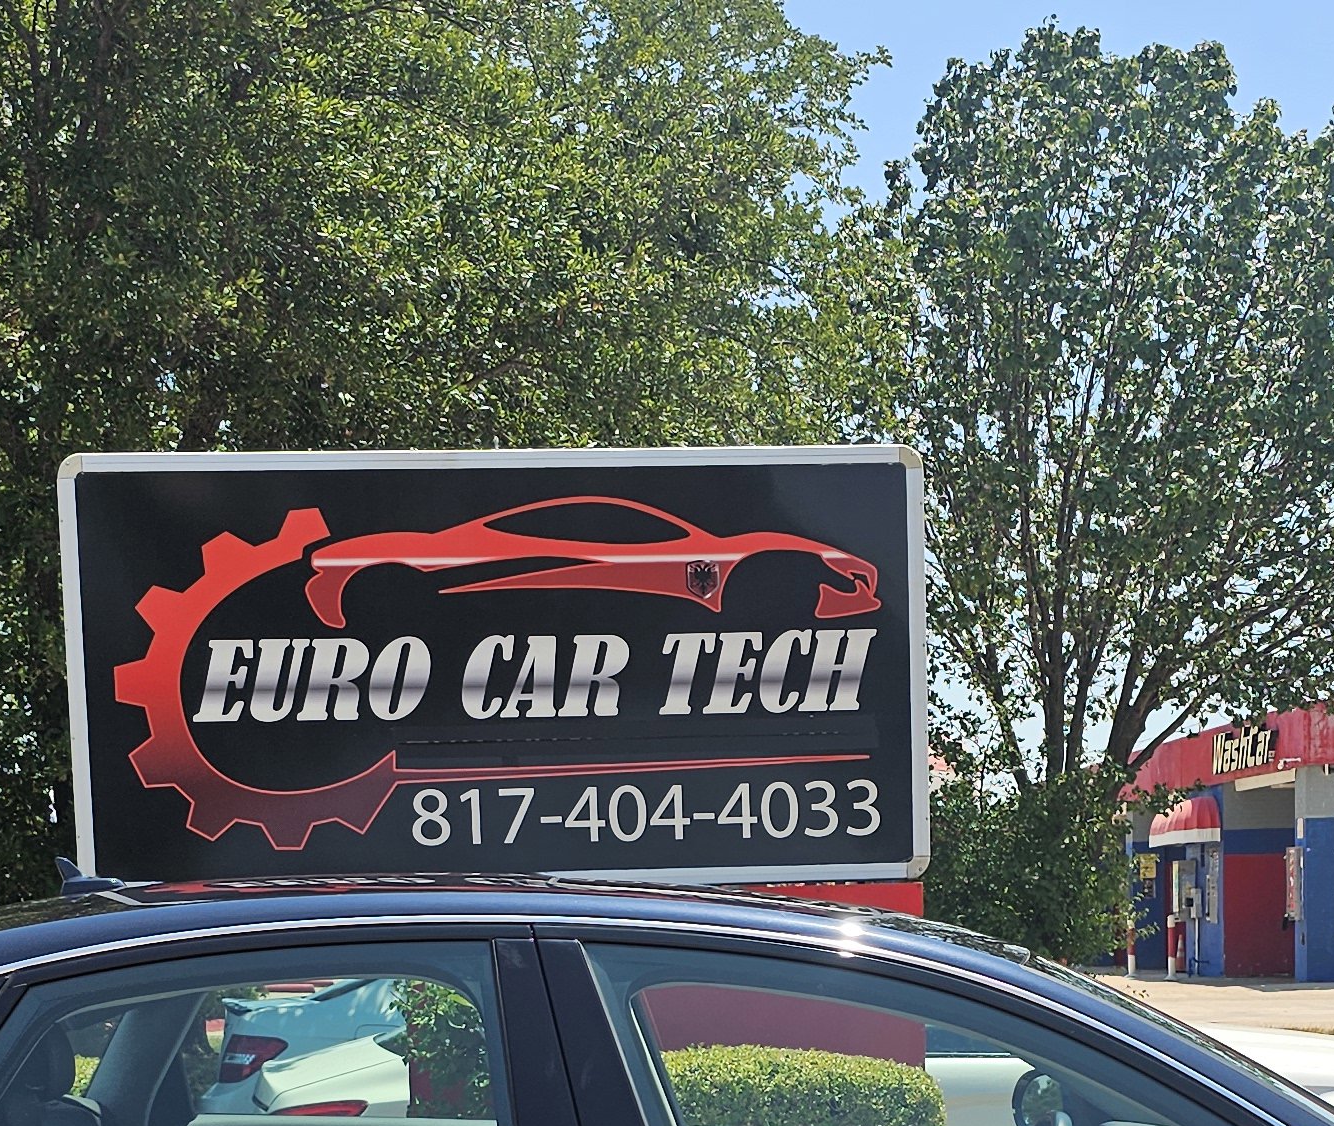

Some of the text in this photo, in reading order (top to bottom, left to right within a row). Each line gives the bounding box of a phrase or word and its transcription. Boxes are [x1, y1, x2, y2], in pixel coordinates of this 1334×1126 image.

[192, 628, 878, 723] EURO CAR TECH
[411, 778, 881, 847] 817-404-4033
